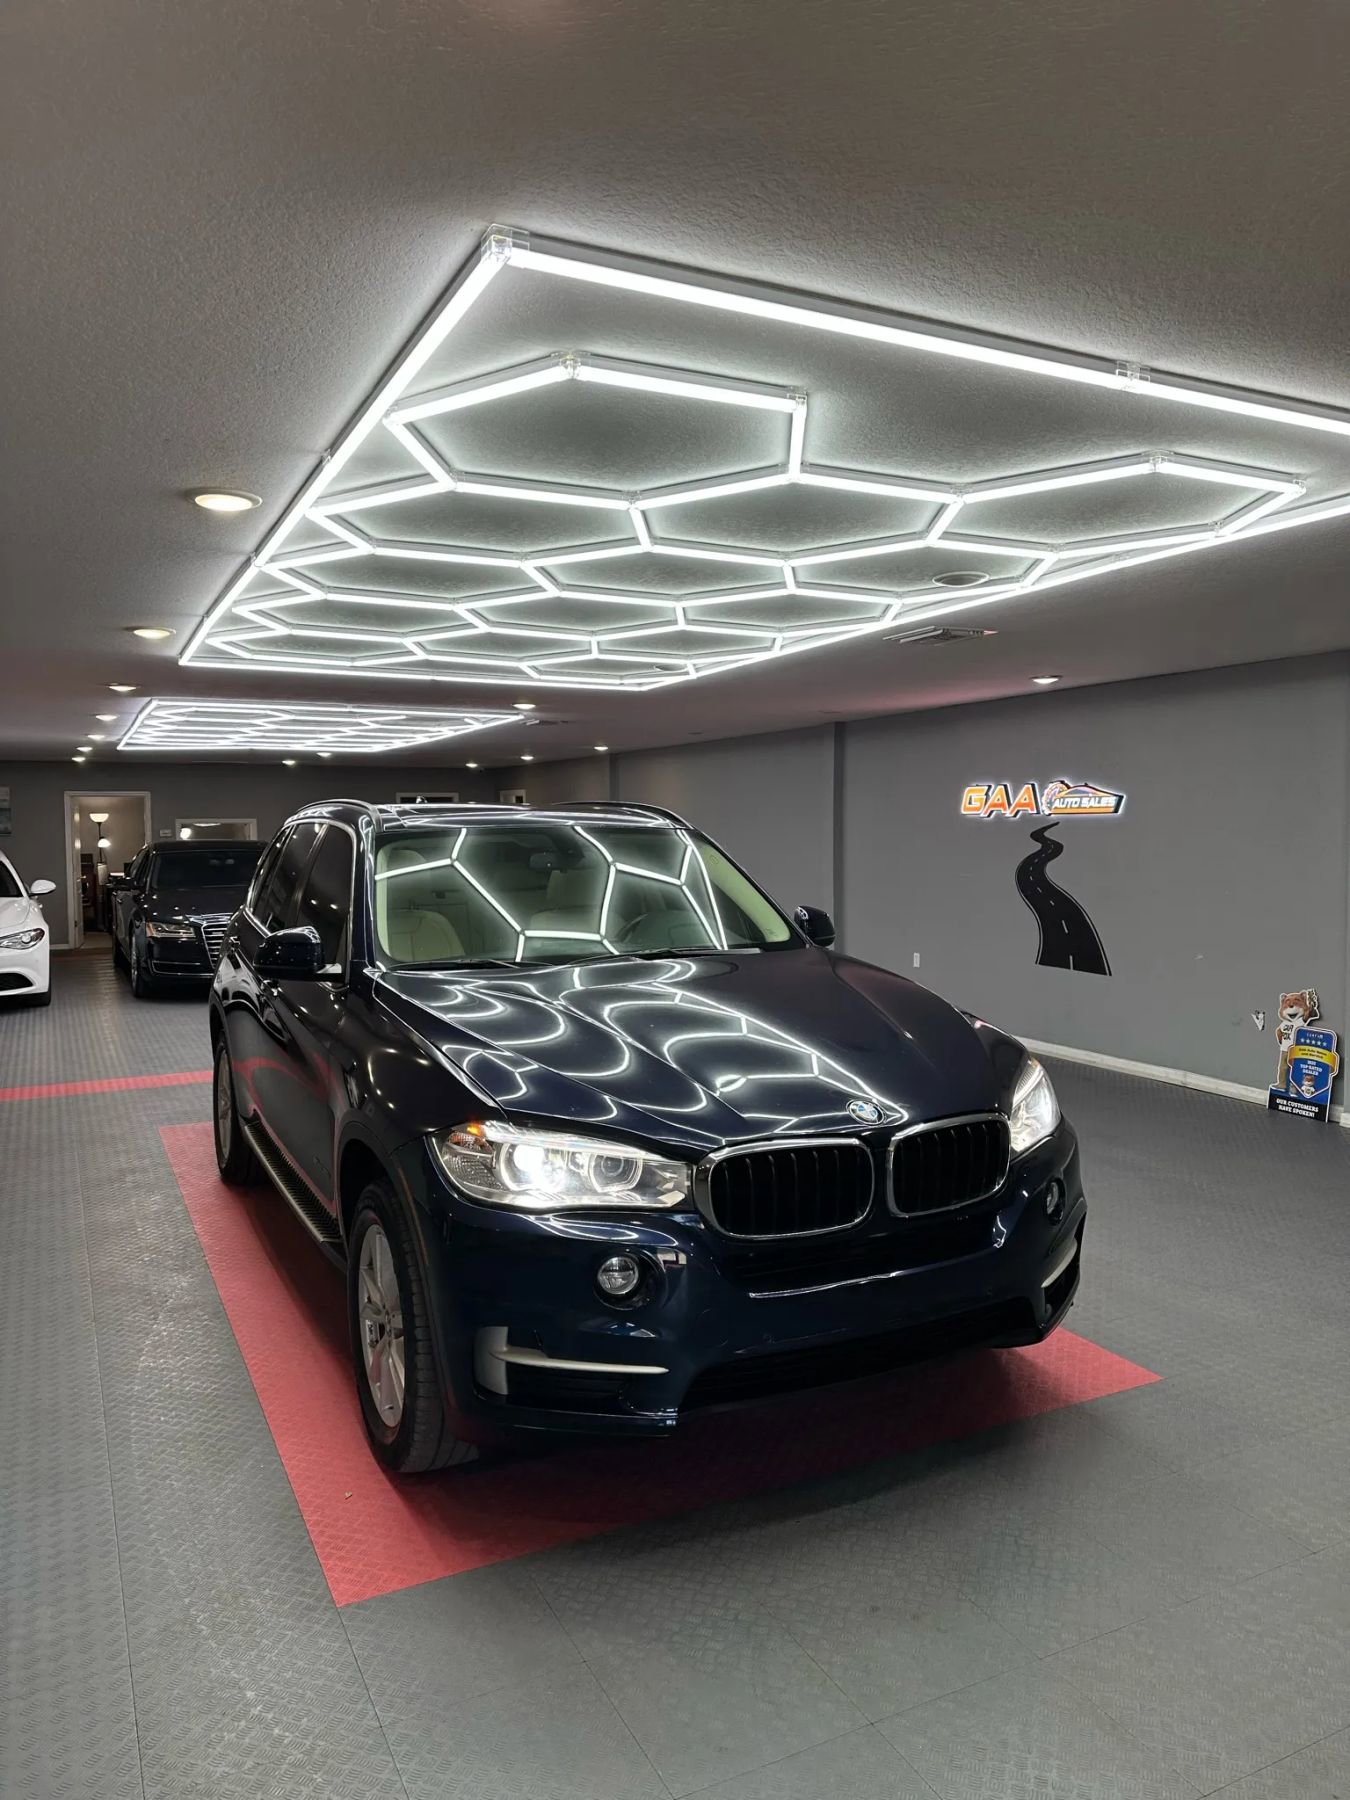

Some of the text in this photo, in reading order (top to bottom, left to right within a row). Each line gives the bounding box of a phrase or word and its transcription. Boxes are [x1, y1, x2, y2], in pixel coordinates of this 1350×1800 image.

[961, 783, 1038, 818] GAA
[1053, 796, 1116, 808] AUTO SALES
[1287, 1101, 1319, 1112] CUSTOMERS
